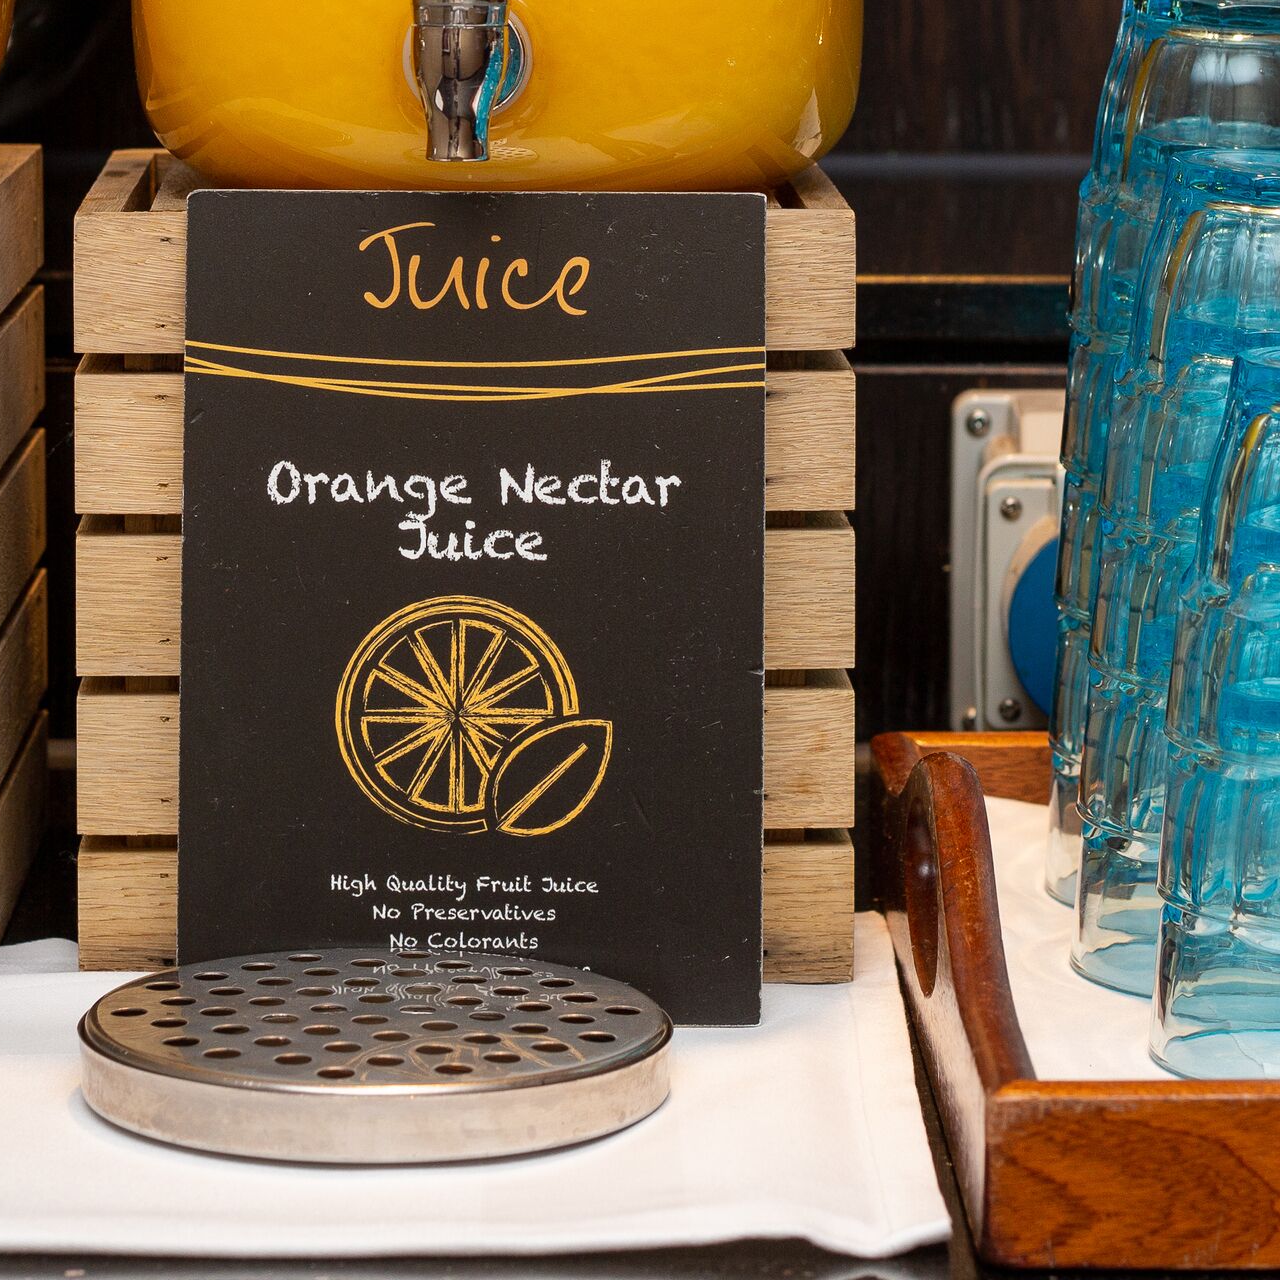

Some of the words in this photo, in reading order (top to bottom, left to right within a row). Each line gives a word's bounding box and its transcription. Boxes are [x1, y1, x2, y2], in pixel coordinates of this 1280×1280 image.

[359, 222, 590, 315] Juice
[267, 460, 471, 517] Orange
[500, 458, 682, 505] Nectar
[399, 512, 547, 562] Juice
[330, 873, 377, 898] High
[386, 874, 467, 902] Quality
[476, 874, 532, 893] Fruit
[541, 876, 599, 894] Juice
[372, 903, 401, 920] No
[410, 902, 556, 922] Preservatives
[390, 933, 417, 950] No
[428, 932, 538, 949] Colorants
